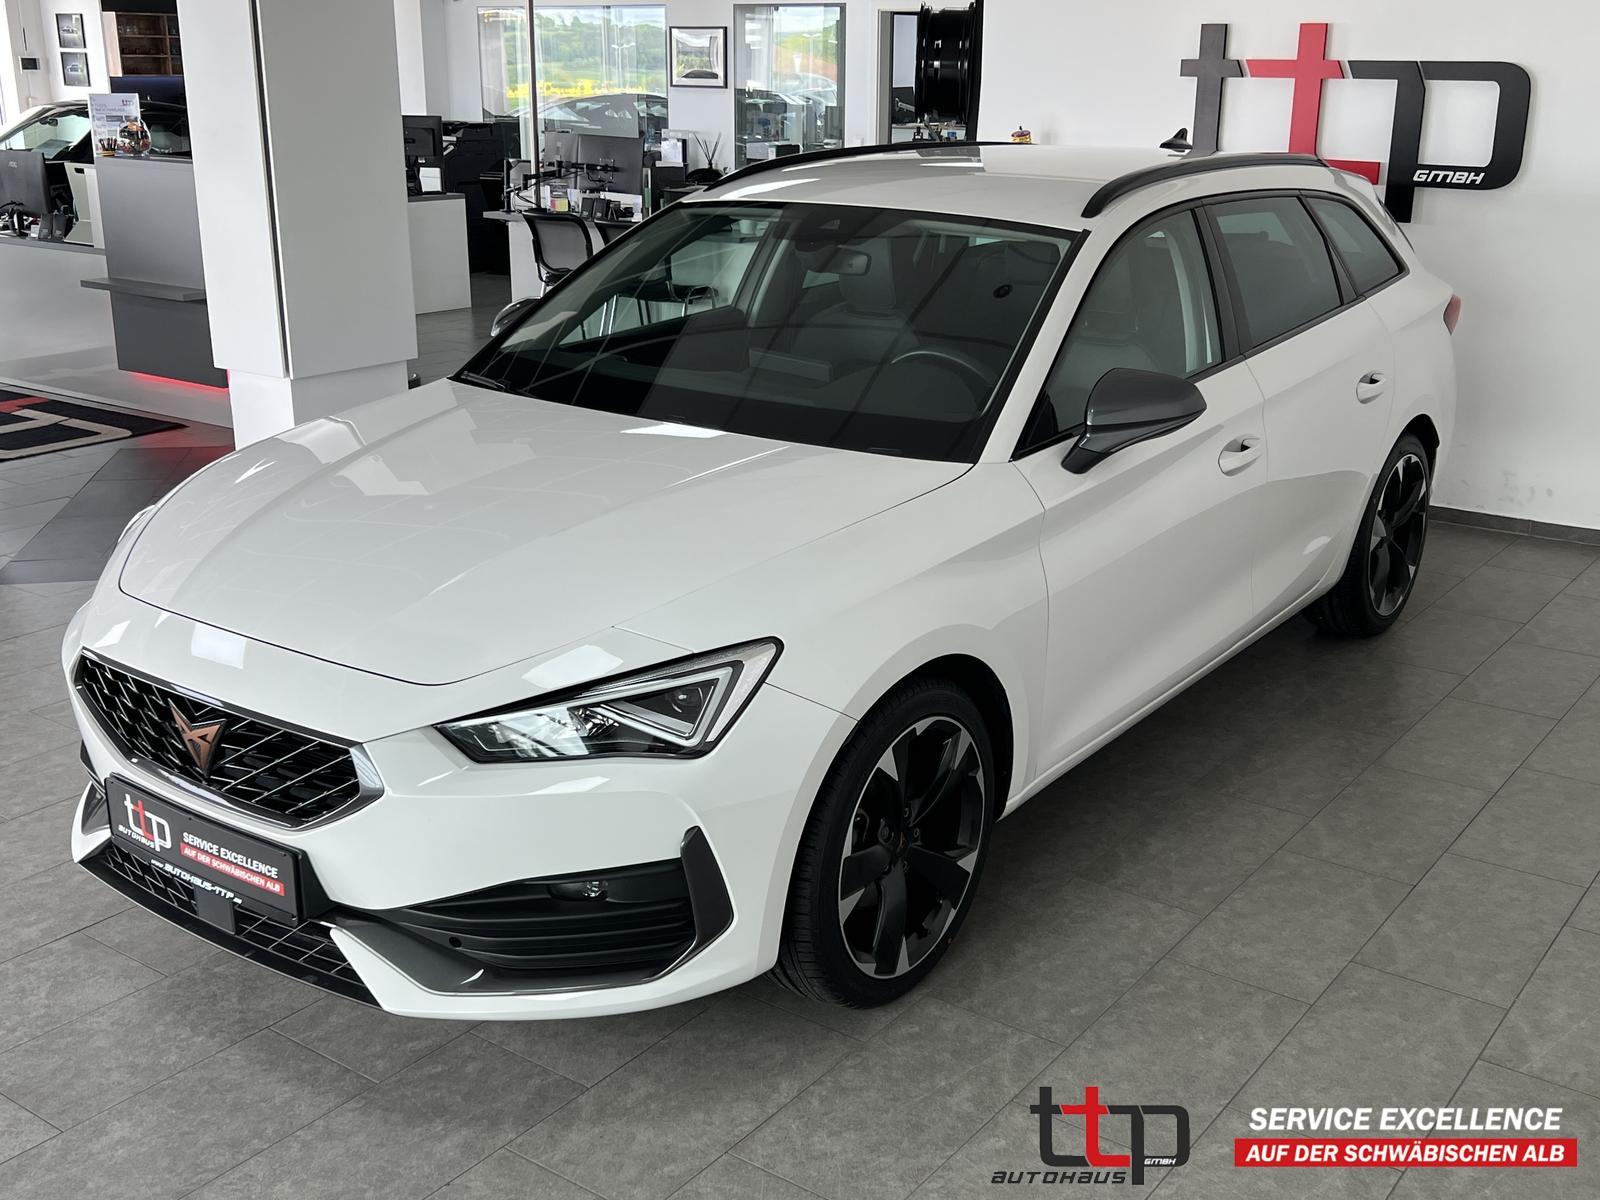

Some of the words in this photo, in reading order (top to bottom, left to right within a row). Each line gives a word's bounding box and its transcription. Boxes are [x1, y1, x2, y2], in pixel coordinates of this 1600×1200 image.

[182, 832, 219, 856] SERVICE
[220, 847, 279, 879] EXCELLENCE
[183, 847, 196, 858] AUF
[197, 852, 211, 866] DER
[211, 859, 265, 887] SCHWÄBISCHEN
[266, 881, 281, 892] ALB
